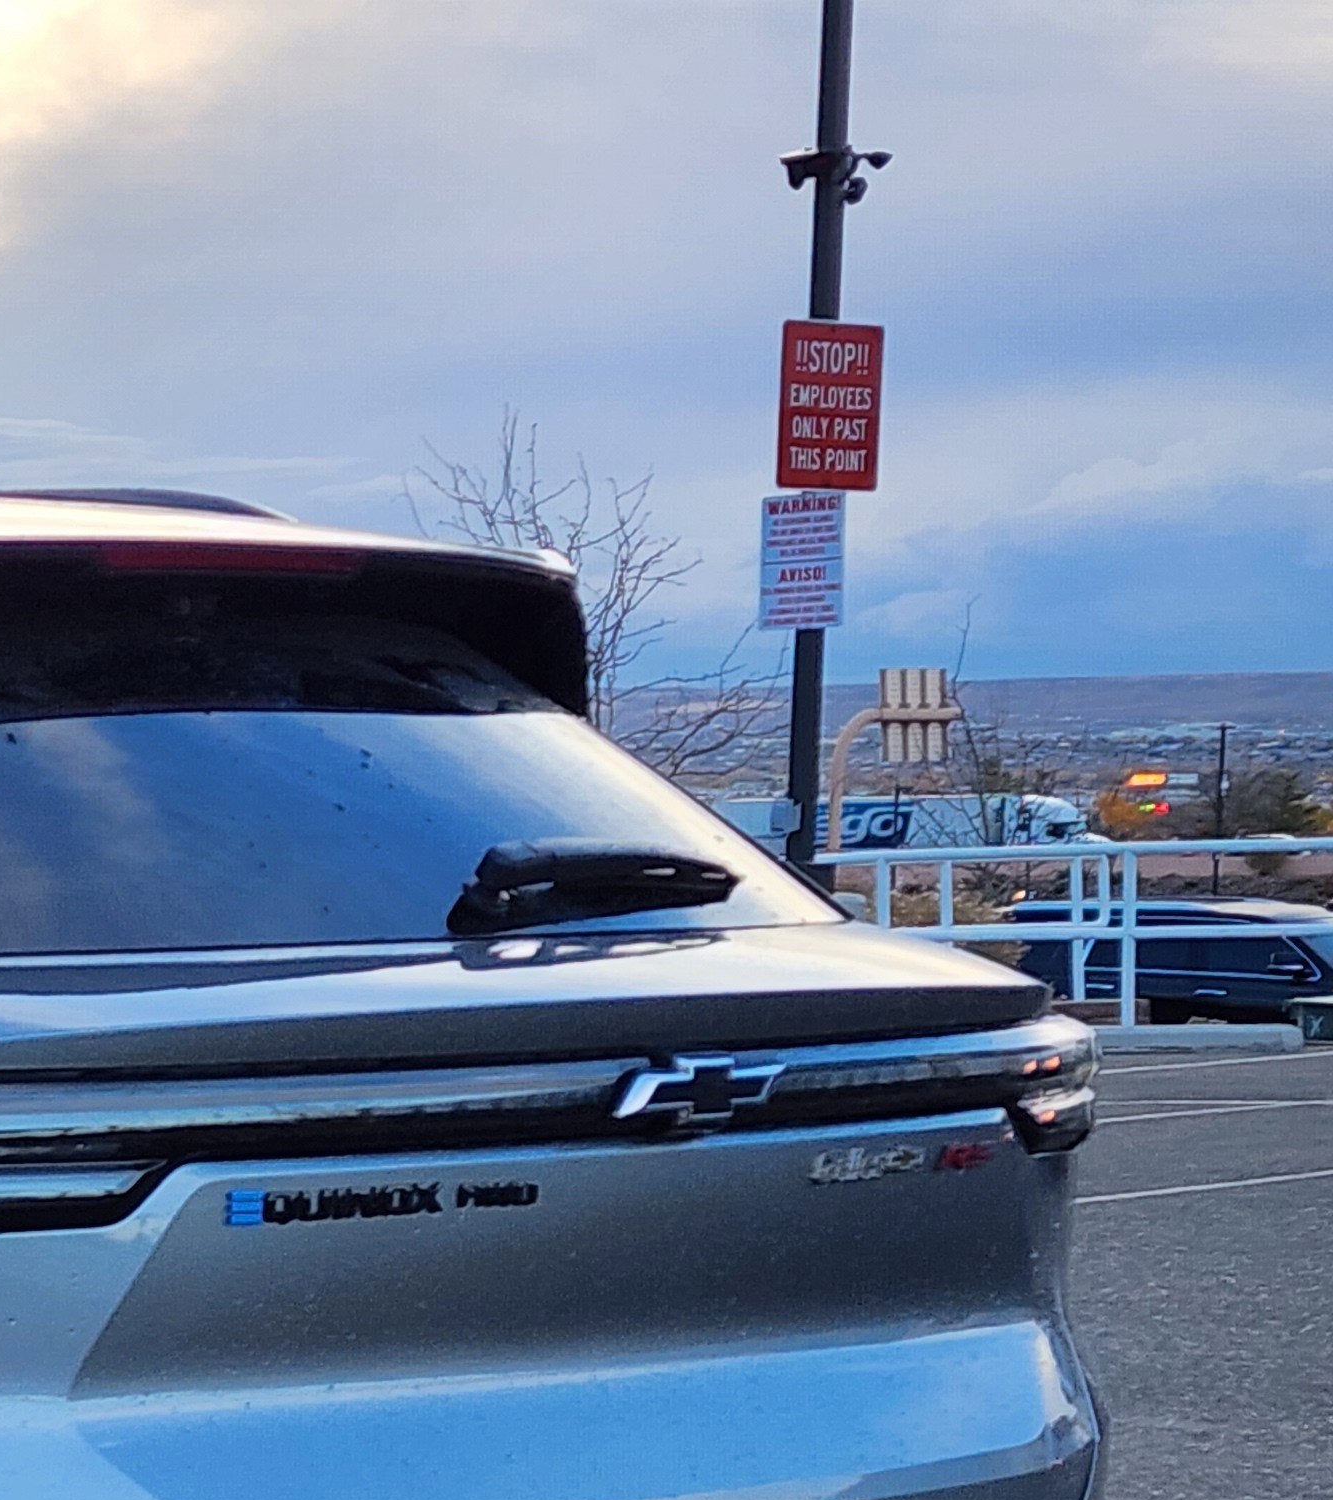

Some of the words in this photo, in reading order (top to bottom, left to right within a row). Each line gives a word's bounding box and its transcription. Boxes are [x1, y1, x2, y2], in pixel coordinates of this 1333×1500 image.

[795, 340, 869, 376] !!STOP!!
[789, 383, 872, 411] EMPLOYEES
[791, 416, 829, 441] ONLY
[833, 417, 867, 441] PAST
[789, 446, 821, 471] THIS
[824, 448, 867, 472] POINT
[767, 495, 841, 515] WARNING!
[778, 566, 827, 582] AVISO!
